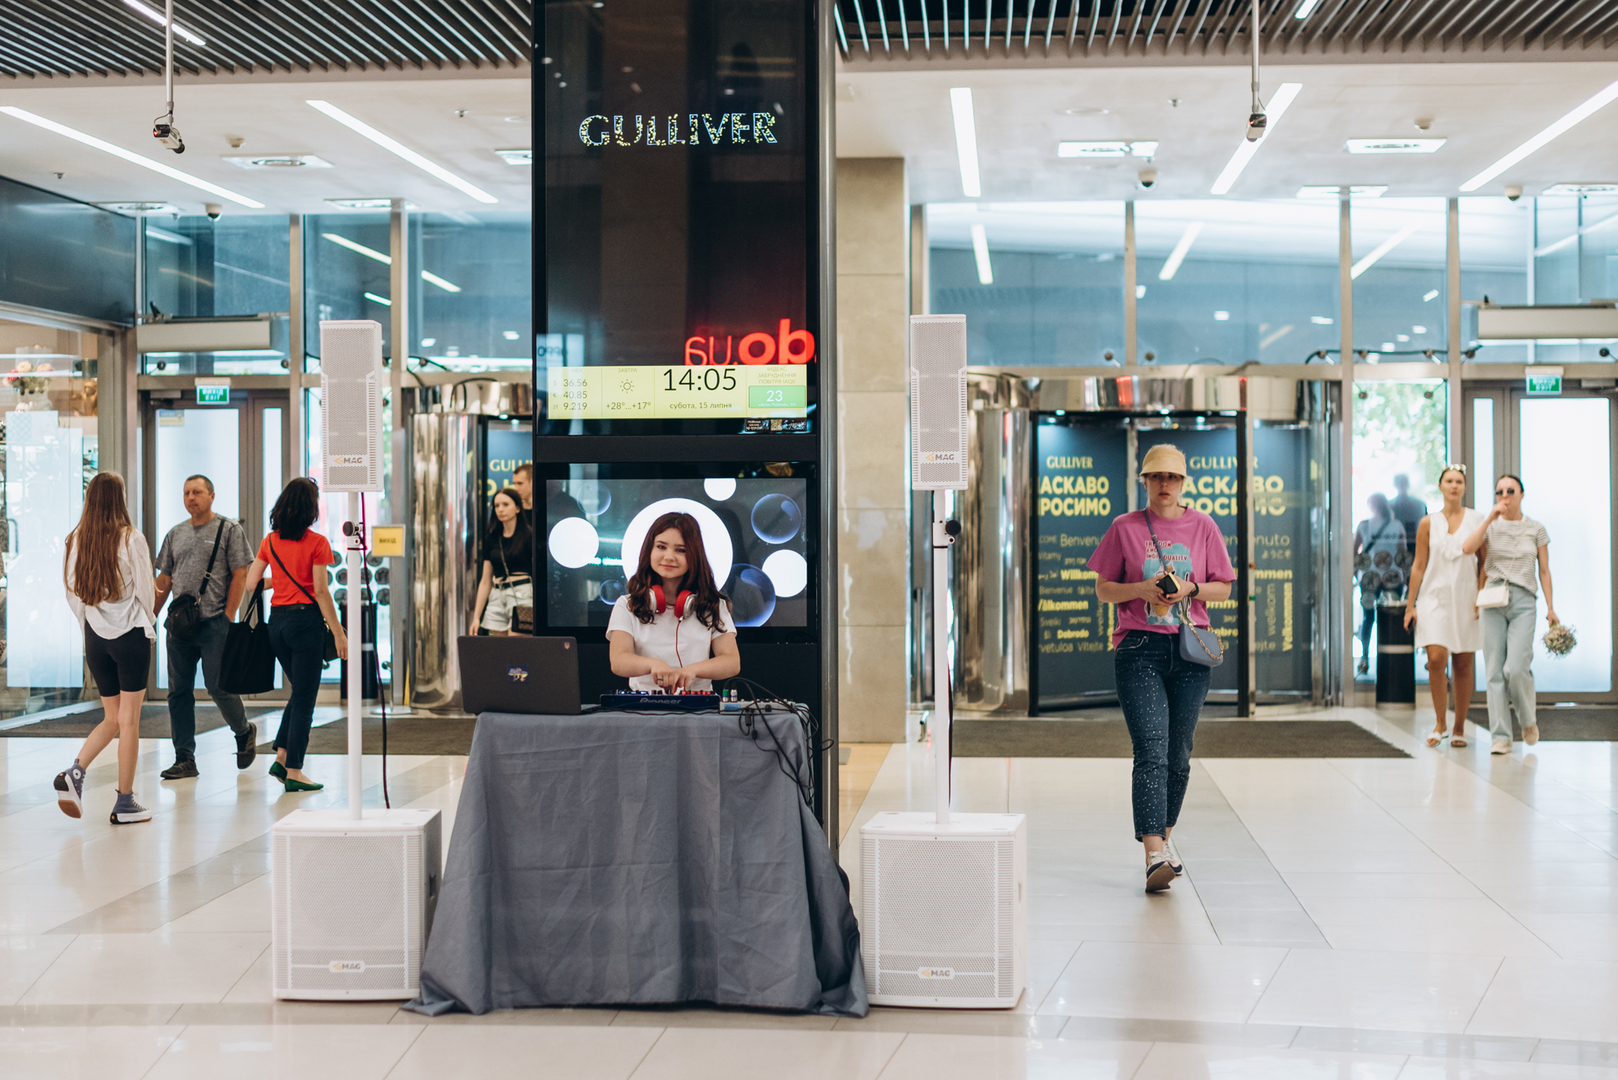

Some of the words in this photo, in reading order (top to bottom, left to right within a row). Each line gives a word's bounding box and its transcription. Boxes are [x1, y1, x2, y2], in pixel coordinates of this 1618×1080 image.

[579, 113, 778, 146] GULLIVER
[563, 378, 588, 387] 36.56
[663, 368, 736, 391] 14:05
[563, 390, 588, 399] 40.85
[766, 389, 783, 402] 23
[563, 402, 588, 410] 9.219
[1046, 456, 1093, 469] GULLIVER
[1038, 475, 1110, 495] АСКАВО
[1037, 497, 1111, 516] РОСИМО
